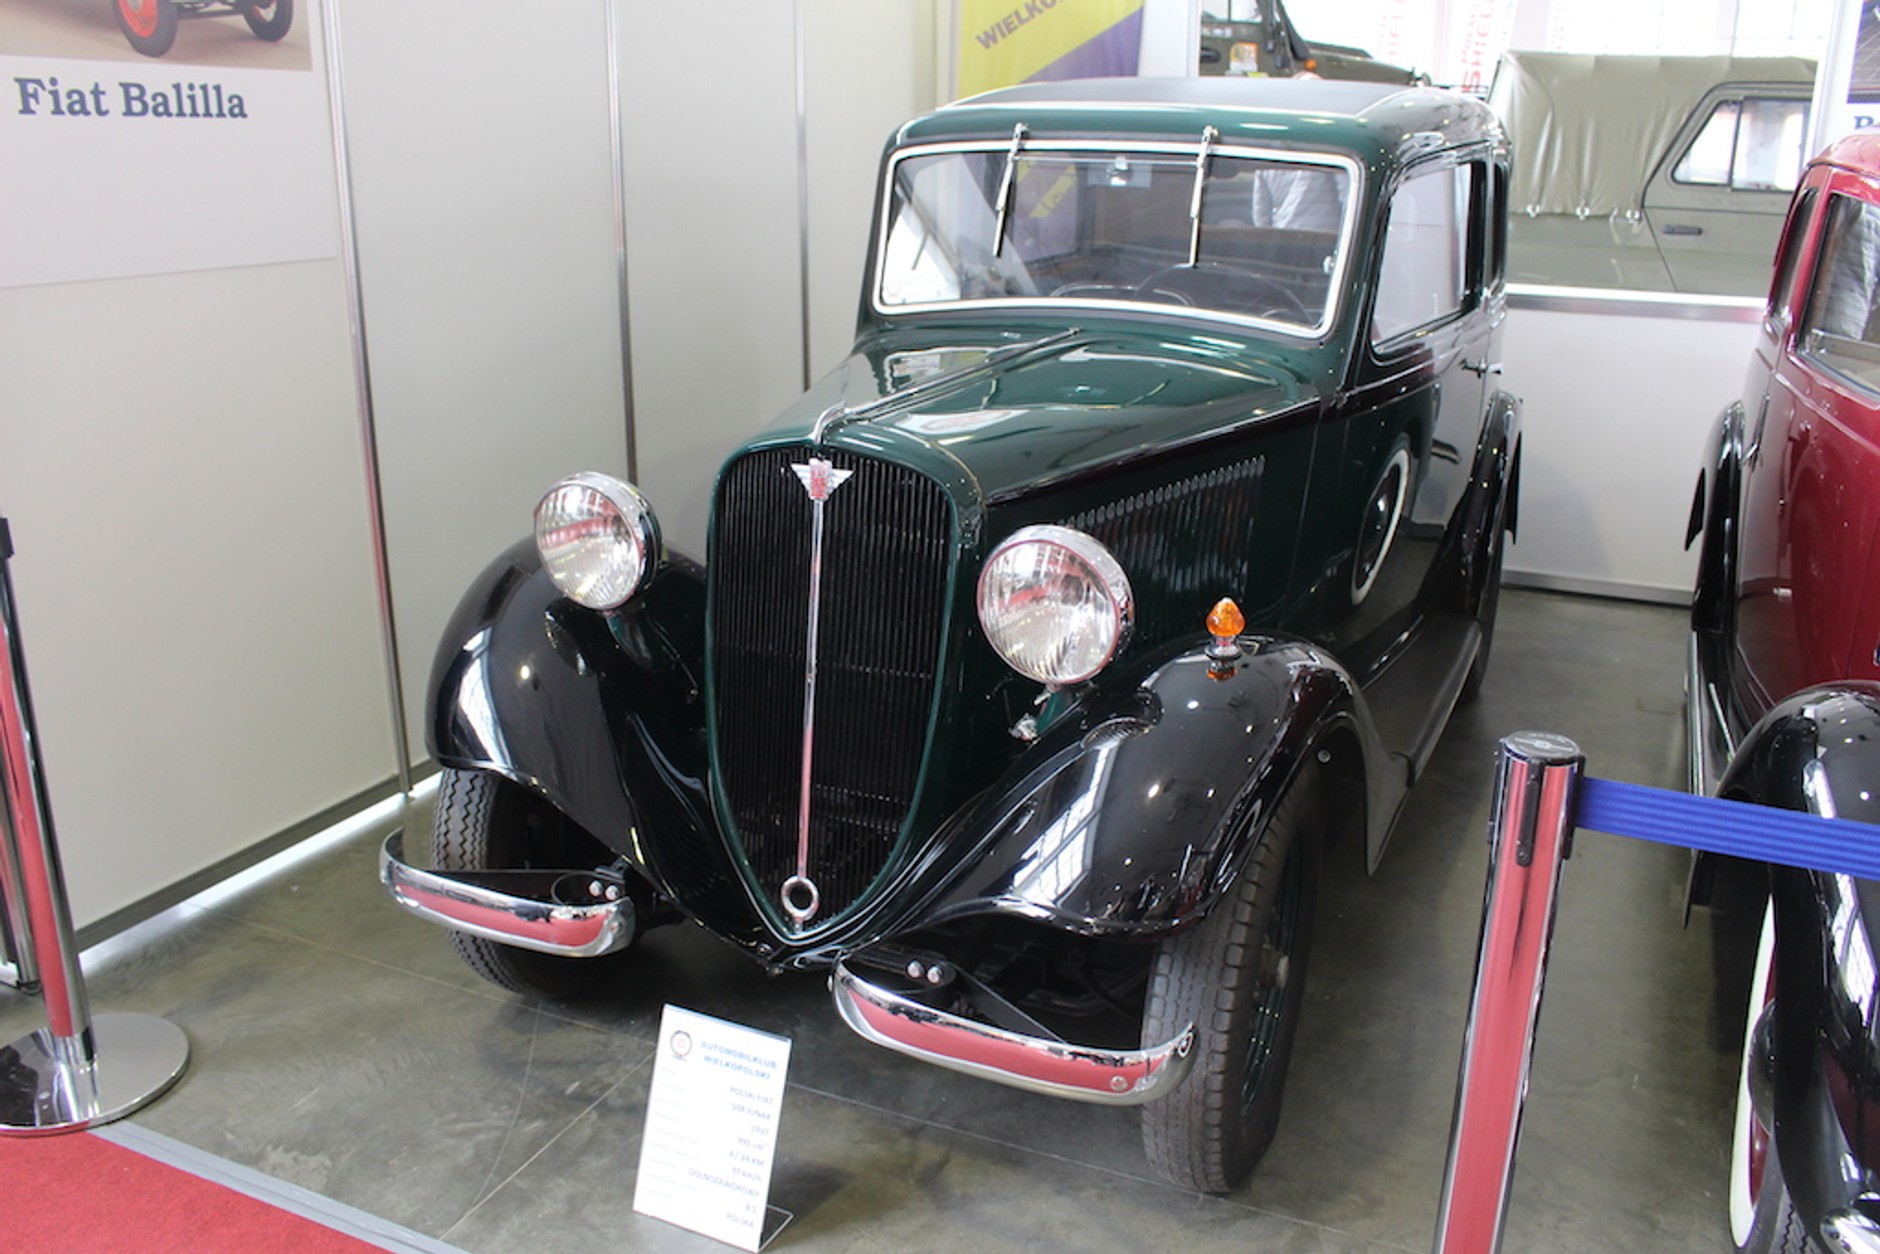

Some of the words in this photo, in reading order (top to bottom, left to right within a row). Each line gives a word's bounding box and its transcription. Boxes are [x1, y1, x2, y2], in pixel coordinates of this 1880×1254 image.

[975, 0, 1060, 50] WIELKO
[1460, 0, 1496, 93] SHIEL
[13, 76, 110, 117] Fiat
[118, 81, 249, 119] Balilla
[701, 1041, 777, 1069] AUTOMOBILKLUB
[704, 1055, 770, 1080] WIELKOPOLSKI
